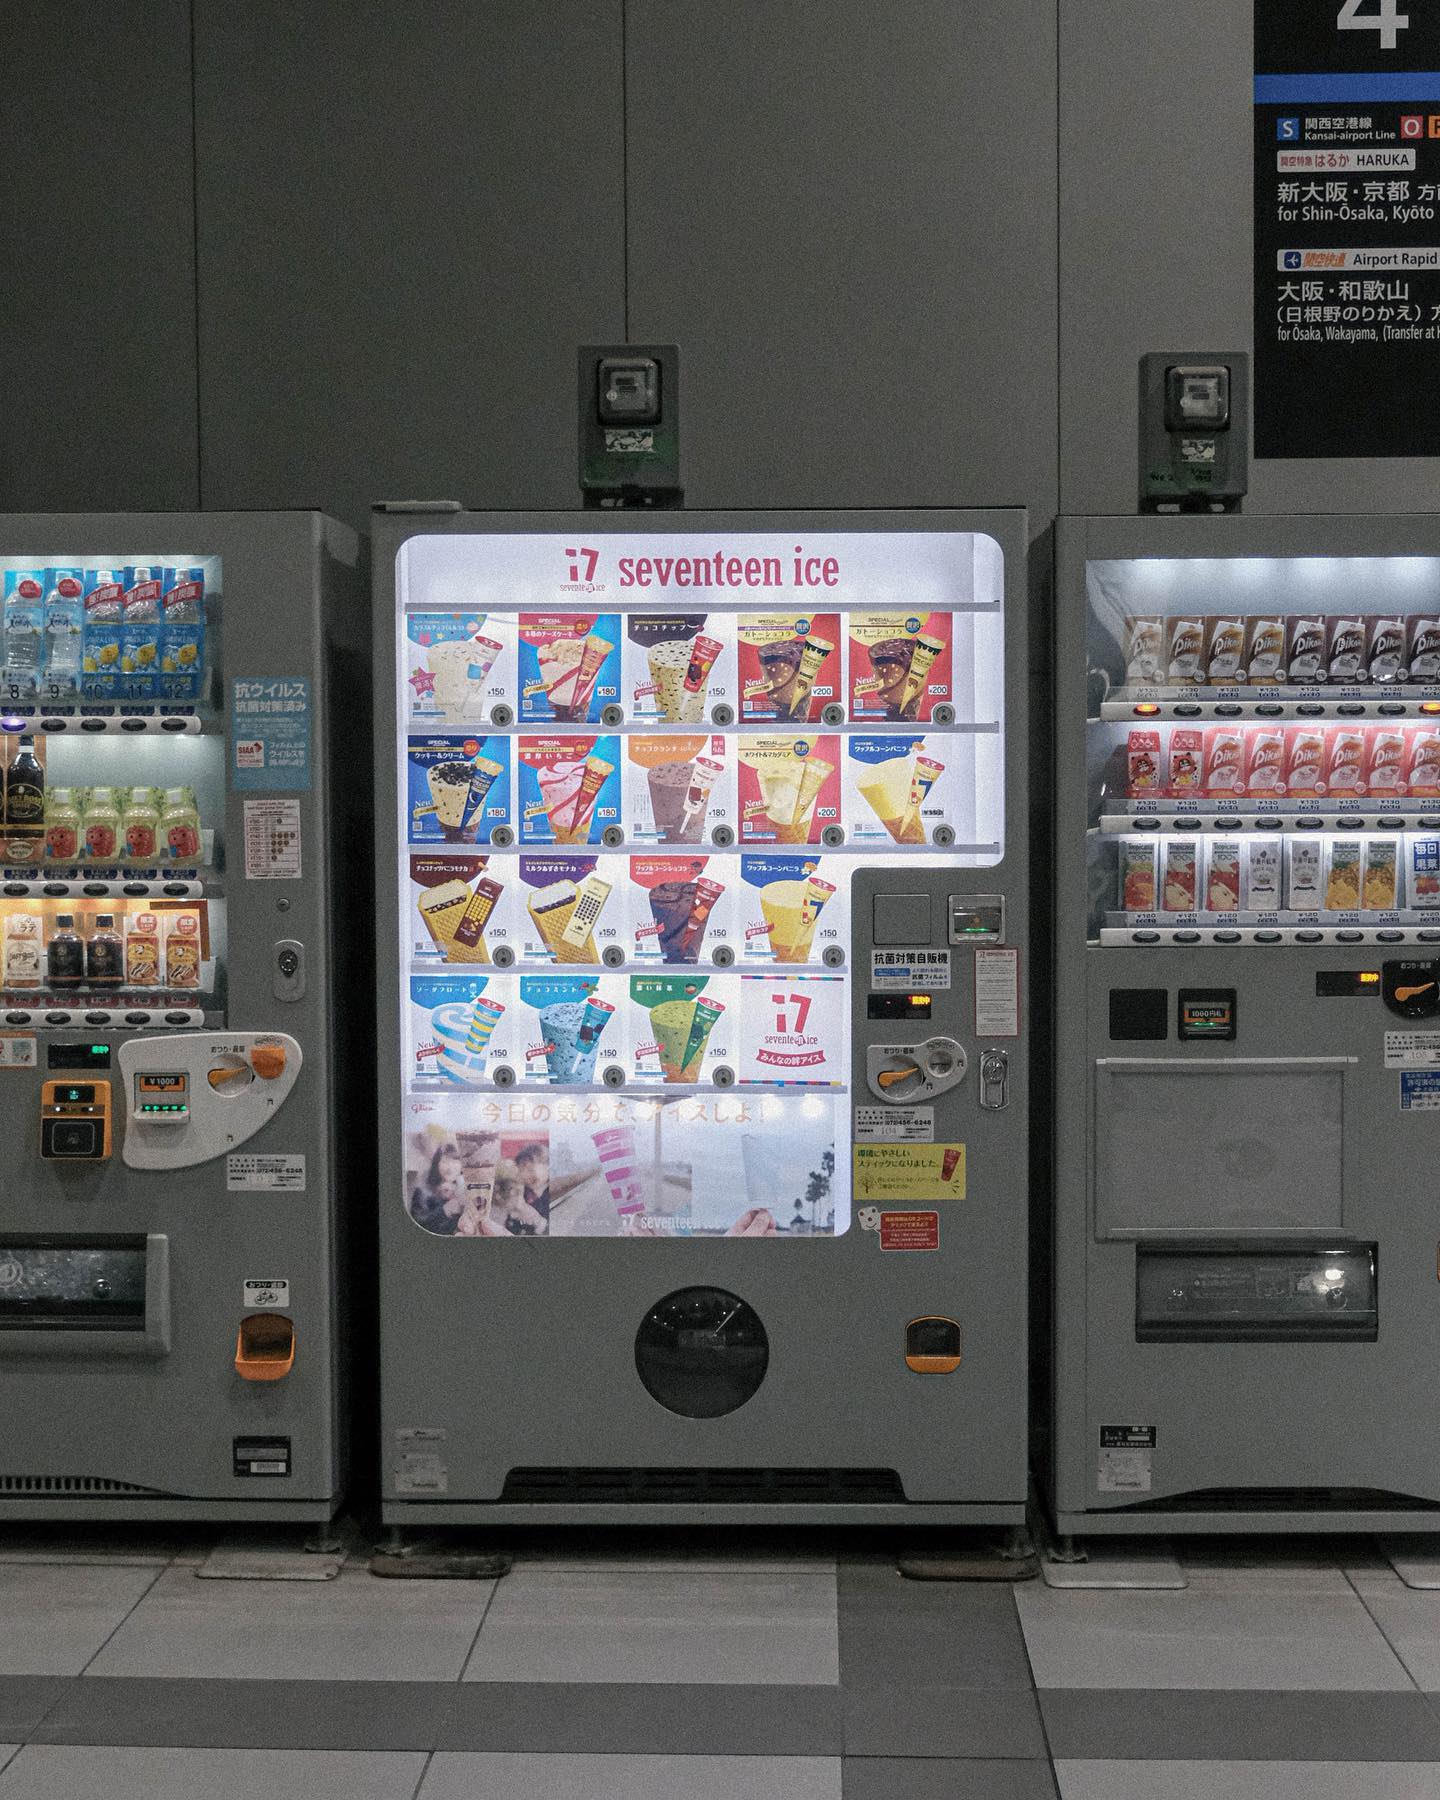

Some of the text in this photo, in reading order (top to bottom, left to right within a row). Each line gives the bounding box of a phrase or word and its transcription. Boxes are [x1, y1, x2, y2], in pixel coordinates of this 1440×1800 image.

[1337, 0, 1409, 49] 4
[1283, 121, 1293, 137] S
[1305, 117, 1372, 129] 関西空港線
[1305, 131, 1396, 141] Kansai-airport Line
[1315, 154, 1350, 167] はるか
[1356, 154, 1409, 166] HARUKA
[1277, 181, 1410, 203] 新大阪・京都
[1277, 203, 1434, 223] for Shin-Ōsaka, Kyōto
[1353, 253, 1437, 267] Airport Rapid
[1277, 281, 1409, 301] 大阪・和歌山
[1277, 326, 1290, 341] for
[1292, 324, 1323, 342] Ōsaka,
[1325, 325, 1379, 343] Wakayama,
[1383, 324, 1423, 342] (Transfer
[1425, 327, 1435, 340] at
[619, 546, 839, 587] seventeen ice
[10, 685, 19, 699] 8
[51, 685, 60, 699] 9
[87, 685, 103, 699] 10
[129, 685, 143, 699] 11
[168, 685, 184, 699] 12
[235, 683, 306, 698] 抗ウイルス
[235, 701, 306, 713] 抗菌対策済み
[1415, 843, 1437, 855] 毎日
[874, 952, 948, 965] 抗菌対策自販機
